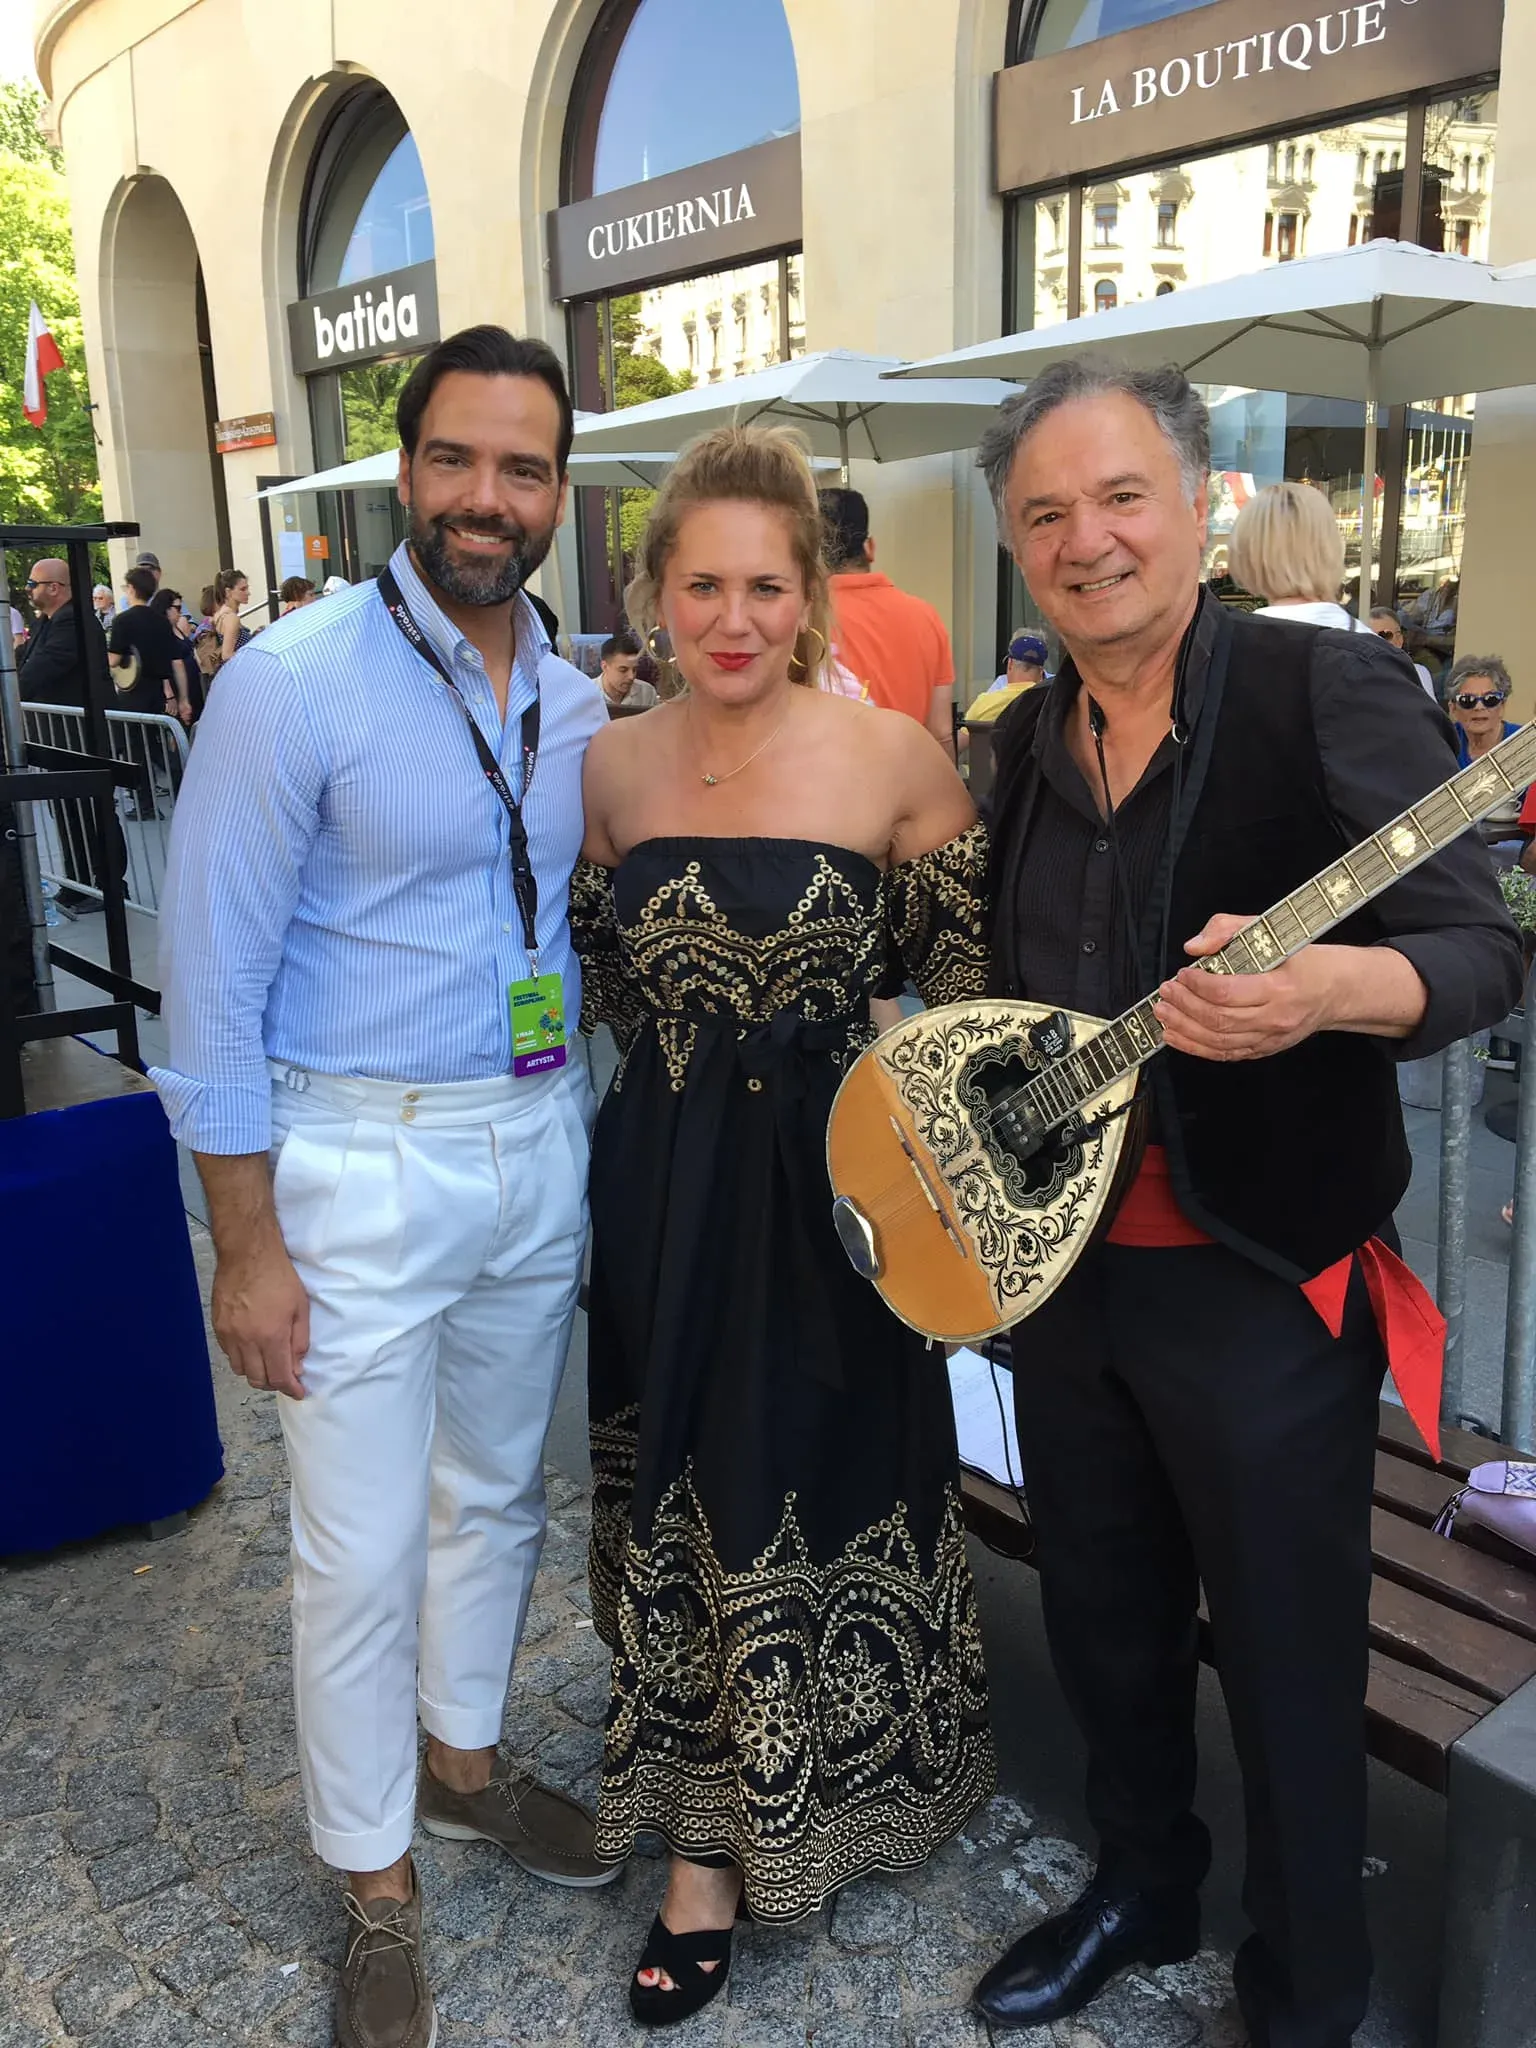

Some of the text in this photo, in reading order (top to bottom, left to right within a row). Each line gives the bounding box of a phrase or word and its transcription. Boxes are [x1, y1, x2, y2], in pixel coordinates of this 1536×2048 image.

[1069, 0, 1387, 125] LA BOUTIQUE
[587, 183, 757, 260] CUKIERNIA
[313, 285, 419, 359] batida
[396, 604, 421, 641] estrada
[526, 1055, 555, 1068] ARTYSTA
